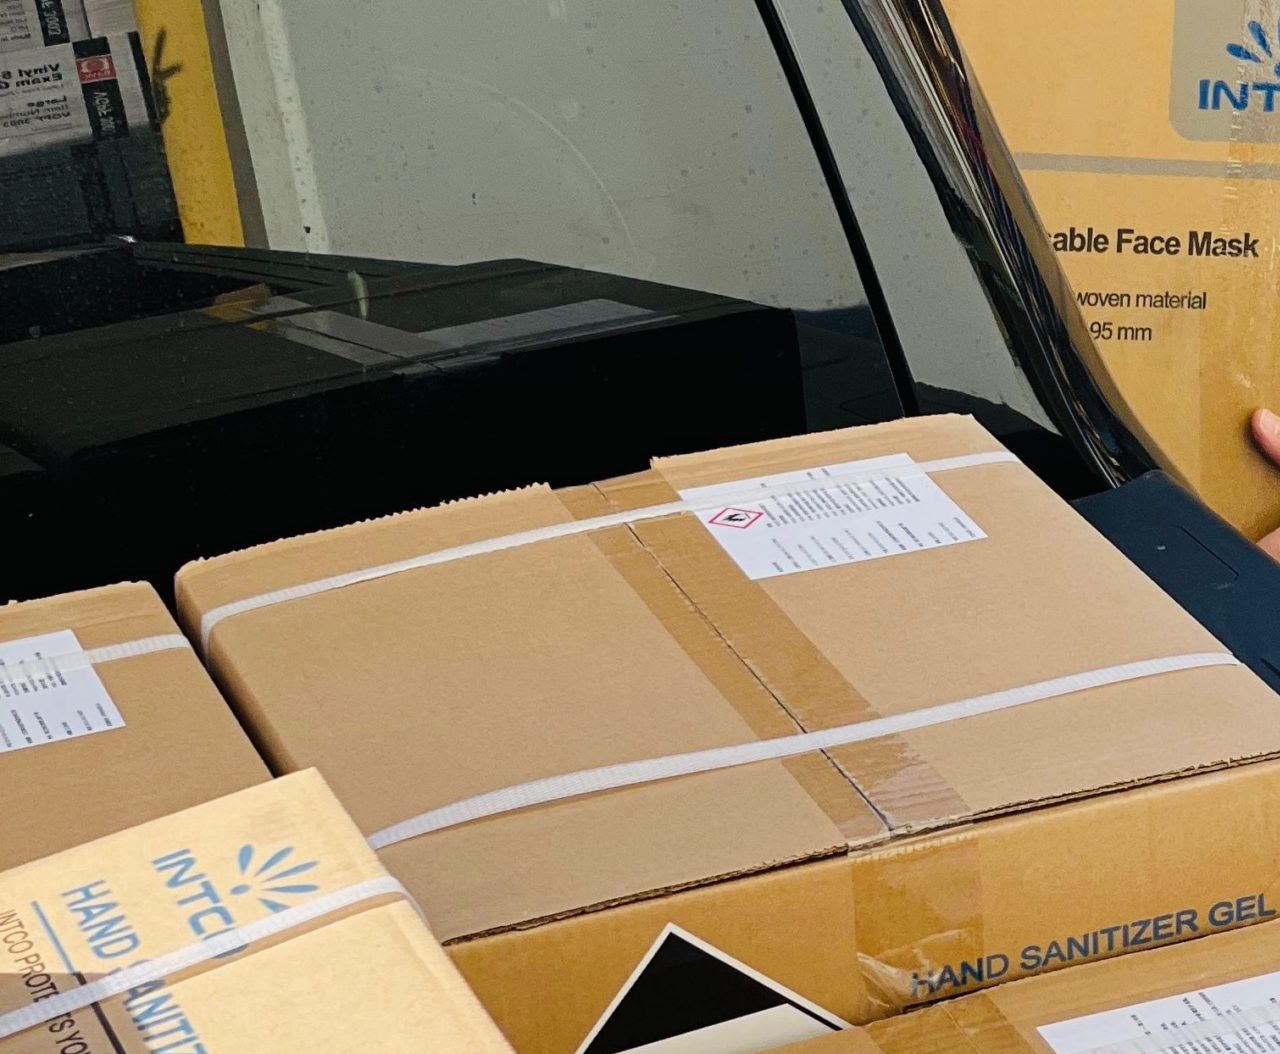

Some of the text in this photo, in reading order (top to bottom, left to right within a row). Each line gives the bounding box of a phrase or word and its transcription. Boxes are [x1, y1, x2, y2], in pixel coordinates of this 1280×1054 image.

[1048, 227, 1260, 258] able Face Mask
[1134, 291, 1207, 310] material
[1089, 321, 1153, 341] 95 mm
[61, 879, 140, 959] HAND
[911, 893, 1278, 997] HAND SANITIZER GEL
